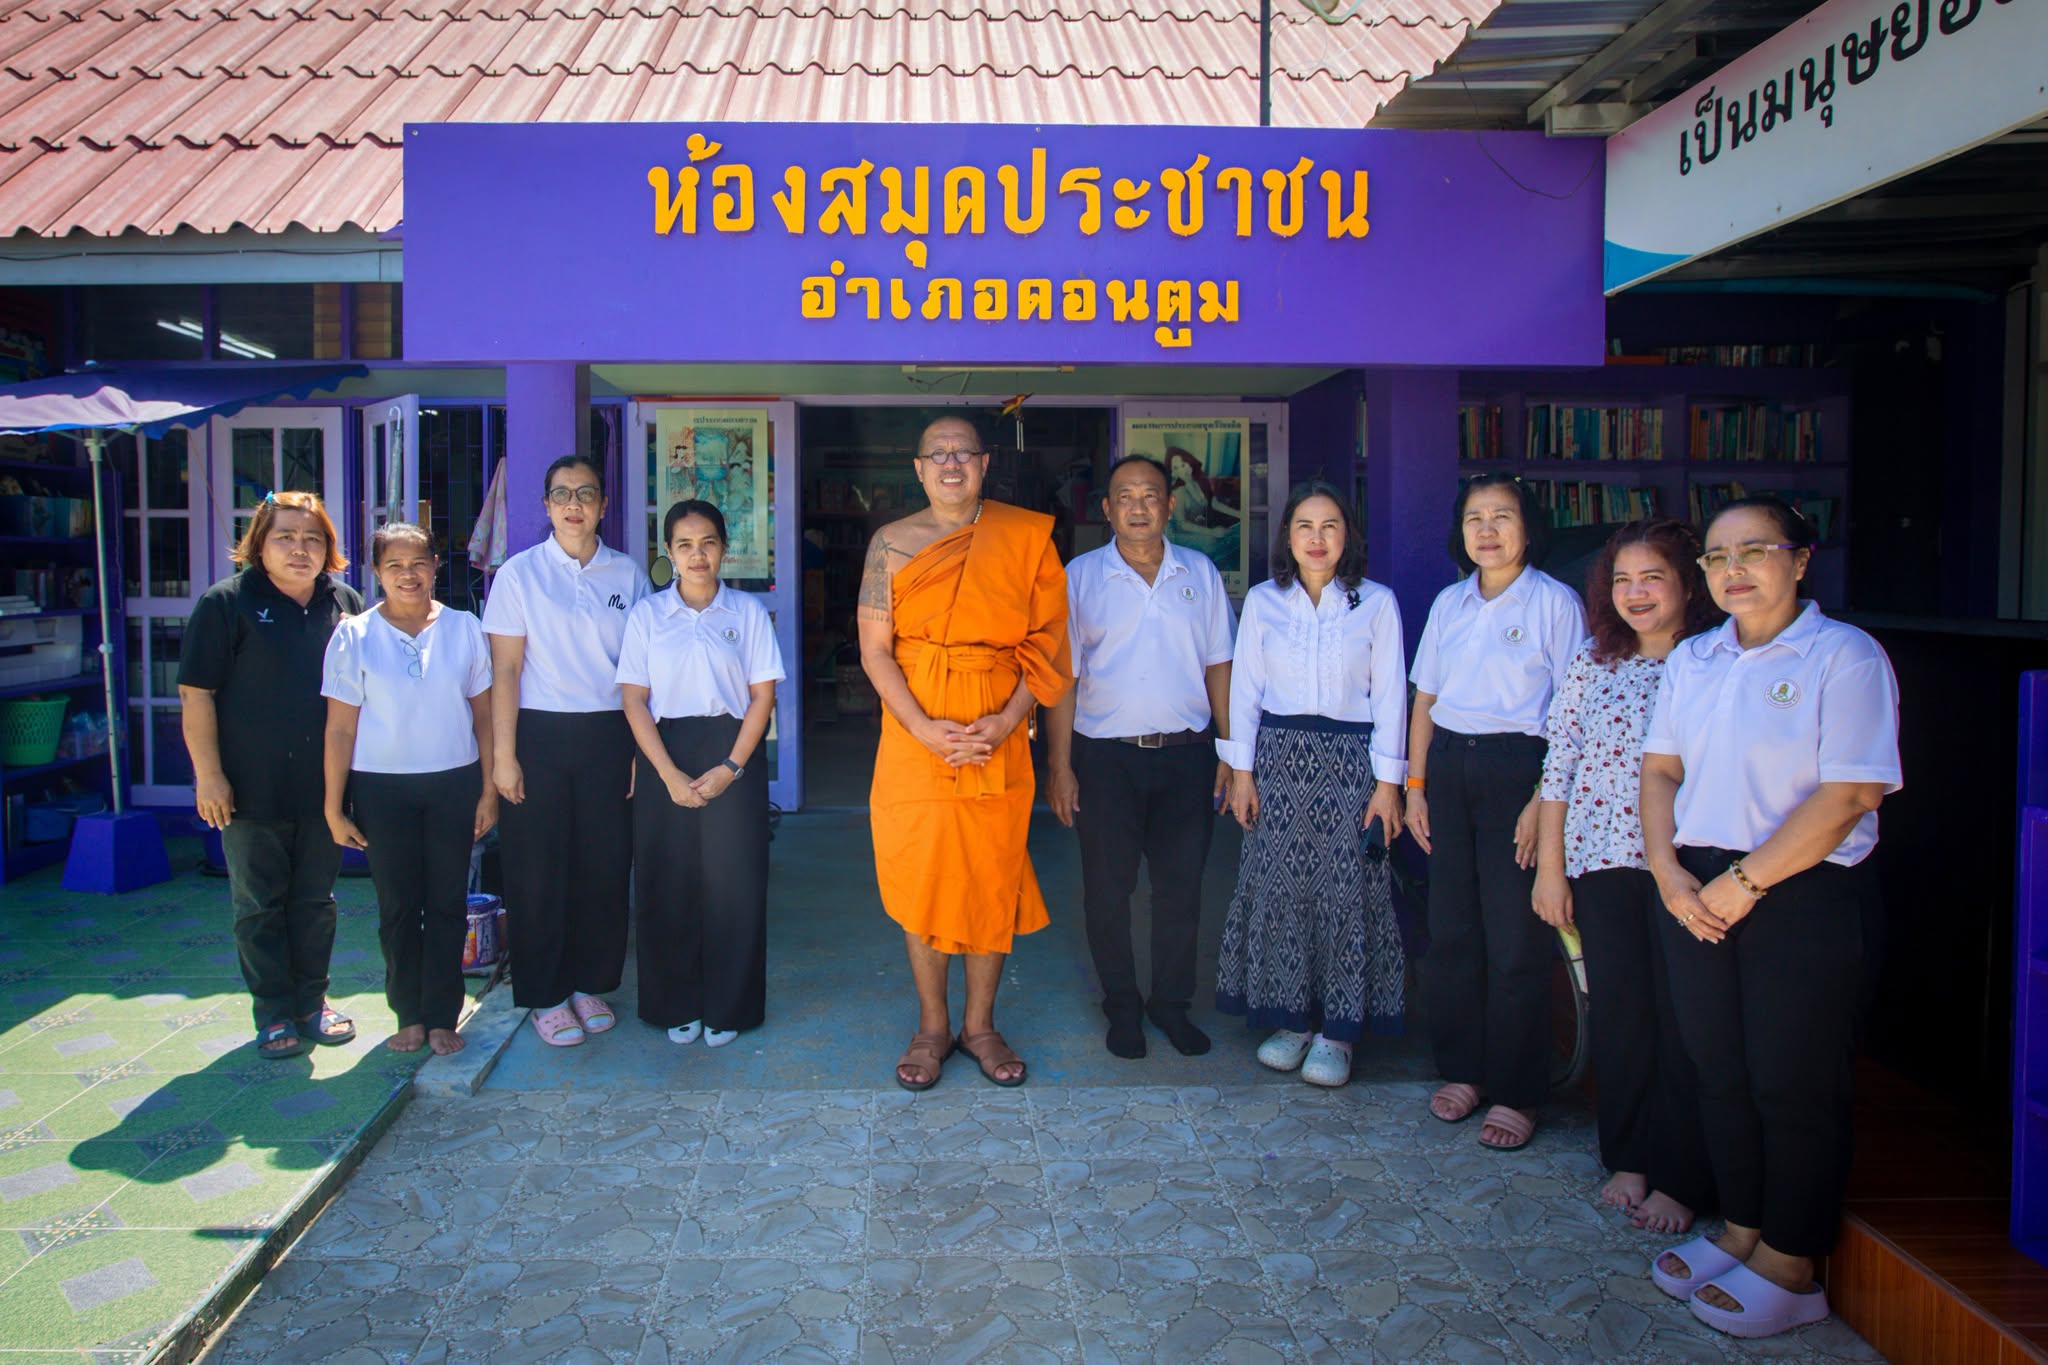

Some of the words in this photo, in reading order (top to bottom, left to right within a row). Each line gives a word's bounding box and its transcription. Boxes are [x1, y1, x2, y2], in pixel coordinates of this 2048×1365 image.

[647, 133, 1371, 268] ห้องสมุดประชาชน
[801, 260, 1240, 347] อำเภอดอนตูม
